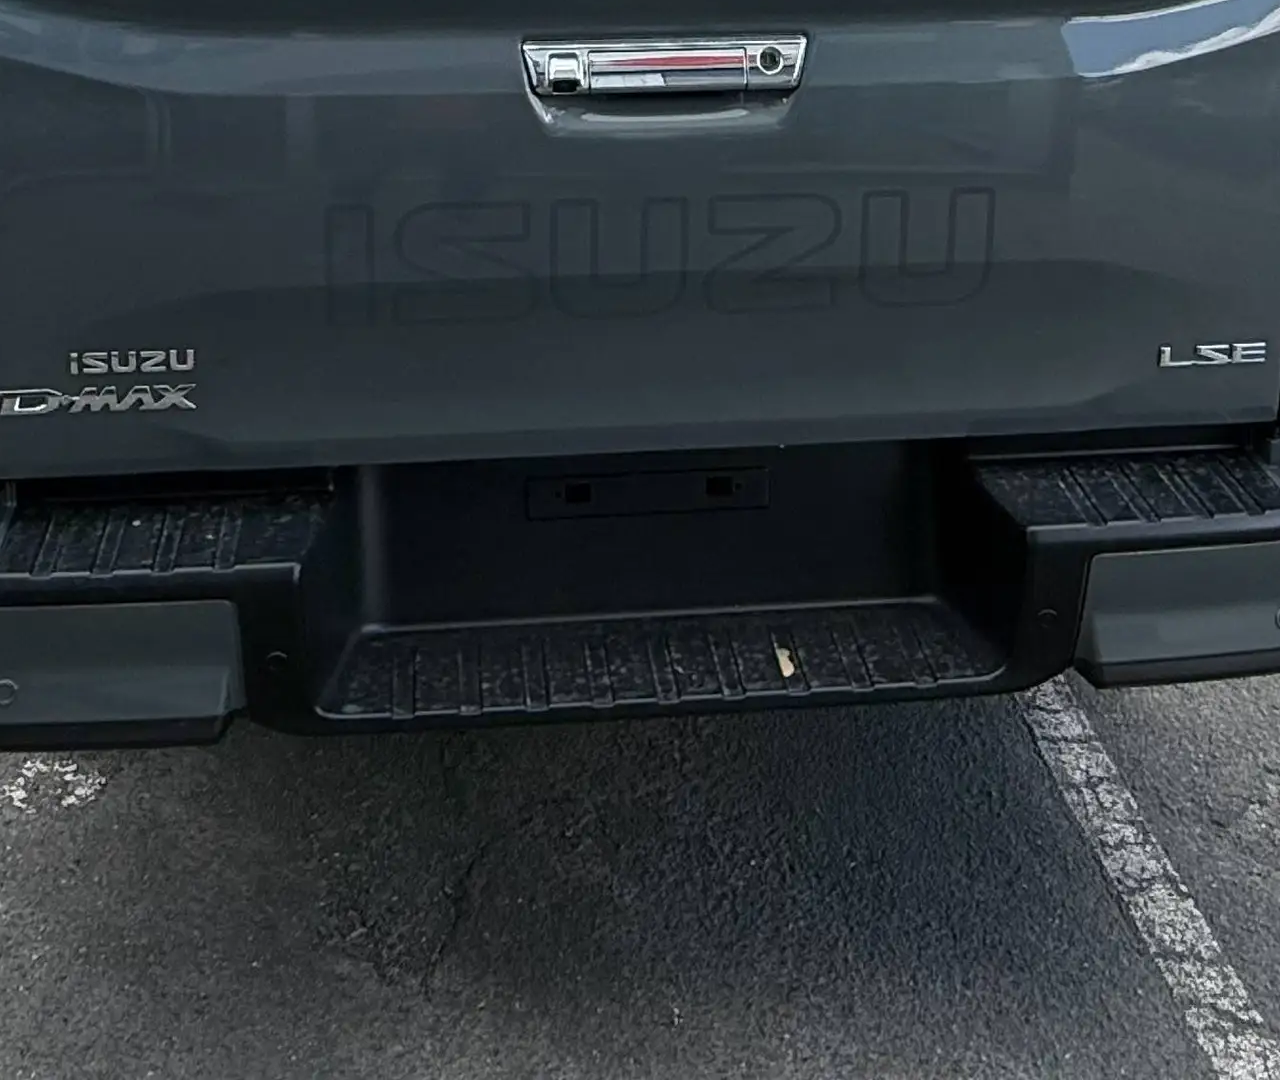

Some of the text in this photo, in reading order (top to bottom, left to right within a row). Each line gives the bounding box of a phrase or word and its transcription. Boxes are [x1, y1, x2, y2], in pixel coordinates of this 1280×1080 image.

[324, 186, 996, 324] ISUZU
[69, 348, 195, 375] ISUZU
[1159, 341, 1267, 368] LSE
